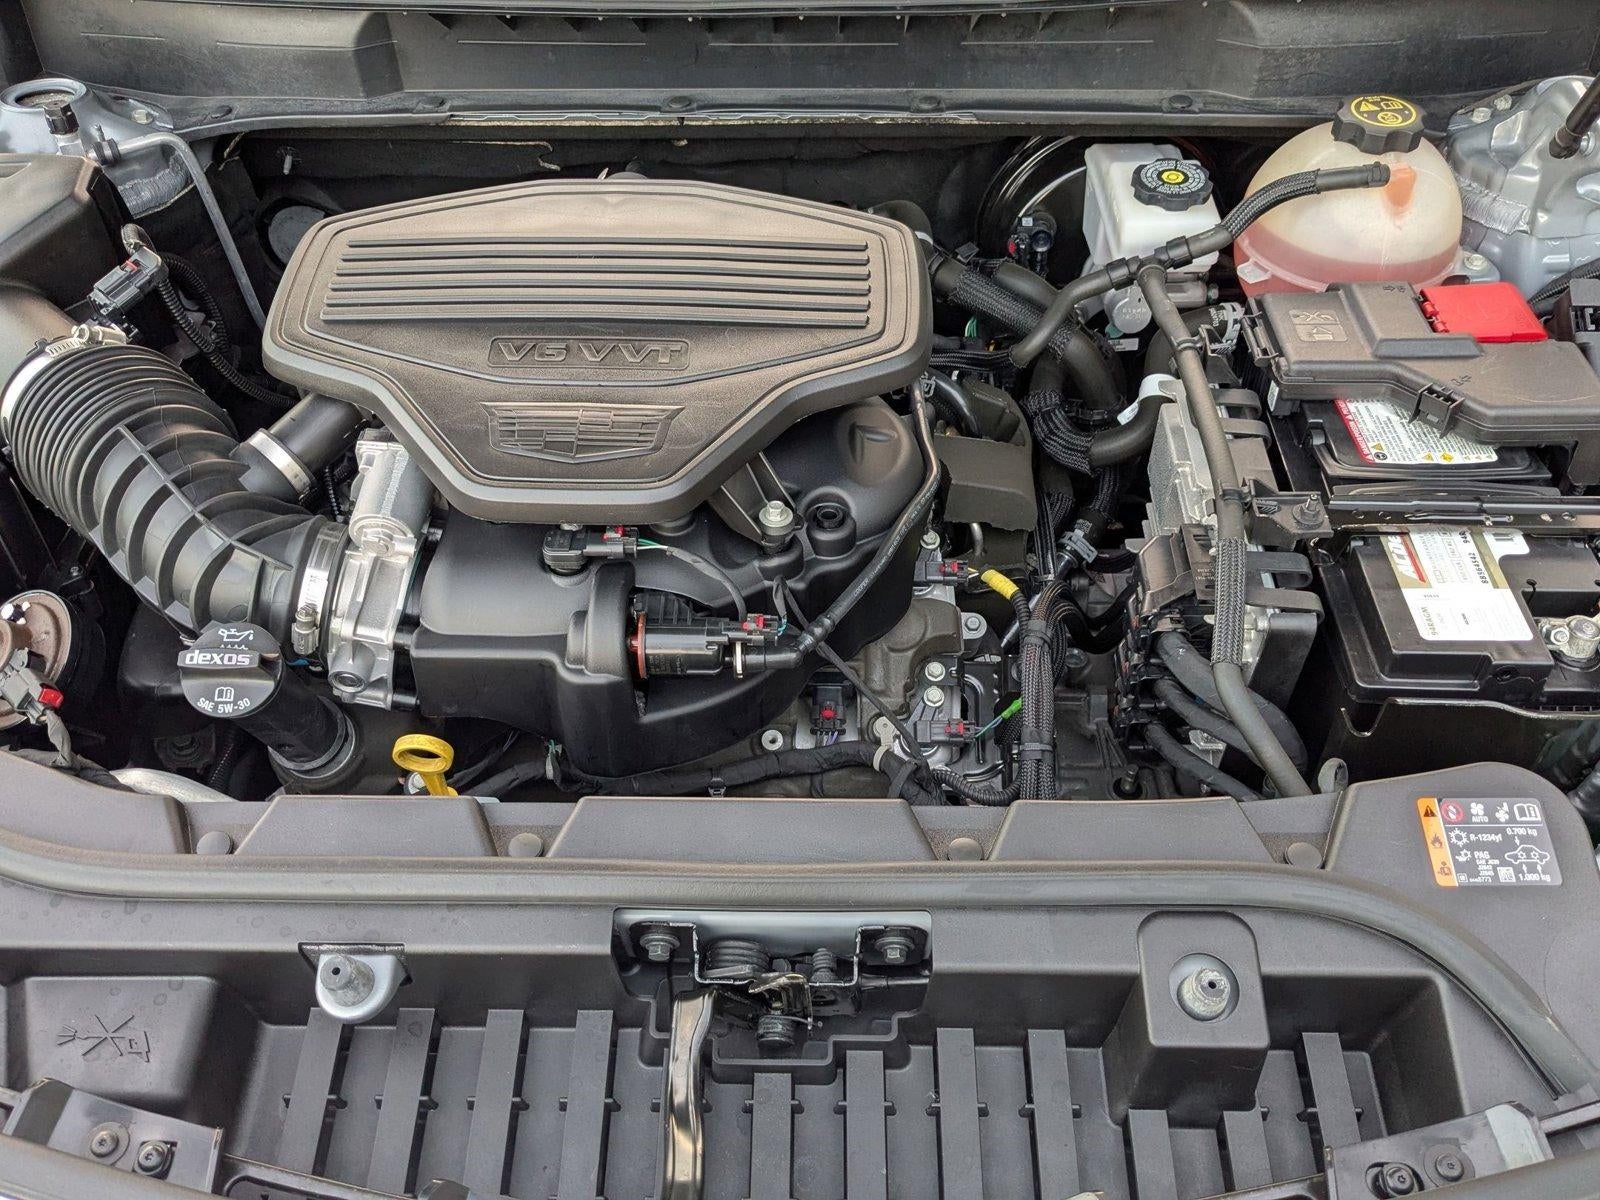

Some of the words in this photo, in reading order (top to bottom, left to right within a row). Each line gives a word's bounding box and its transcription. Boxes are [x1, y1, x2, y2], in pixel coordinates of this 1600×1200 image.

[498, 342, 568, 362] V6
[578, 342, 683, 364] VVT
[185, 650, 251, 666] dexos
[197, 697, 215, 712] SAE
[217, 697, 251, 714] 5W-30
[1506, 827, 1526, 835] 0.700
[1527, 827, 1538, 837] kg
[1469, 833, 1503, 843] R-1234yf
[1473, 851, 1490, 859] PAG
[1540, 873, 1551, 882] kg
